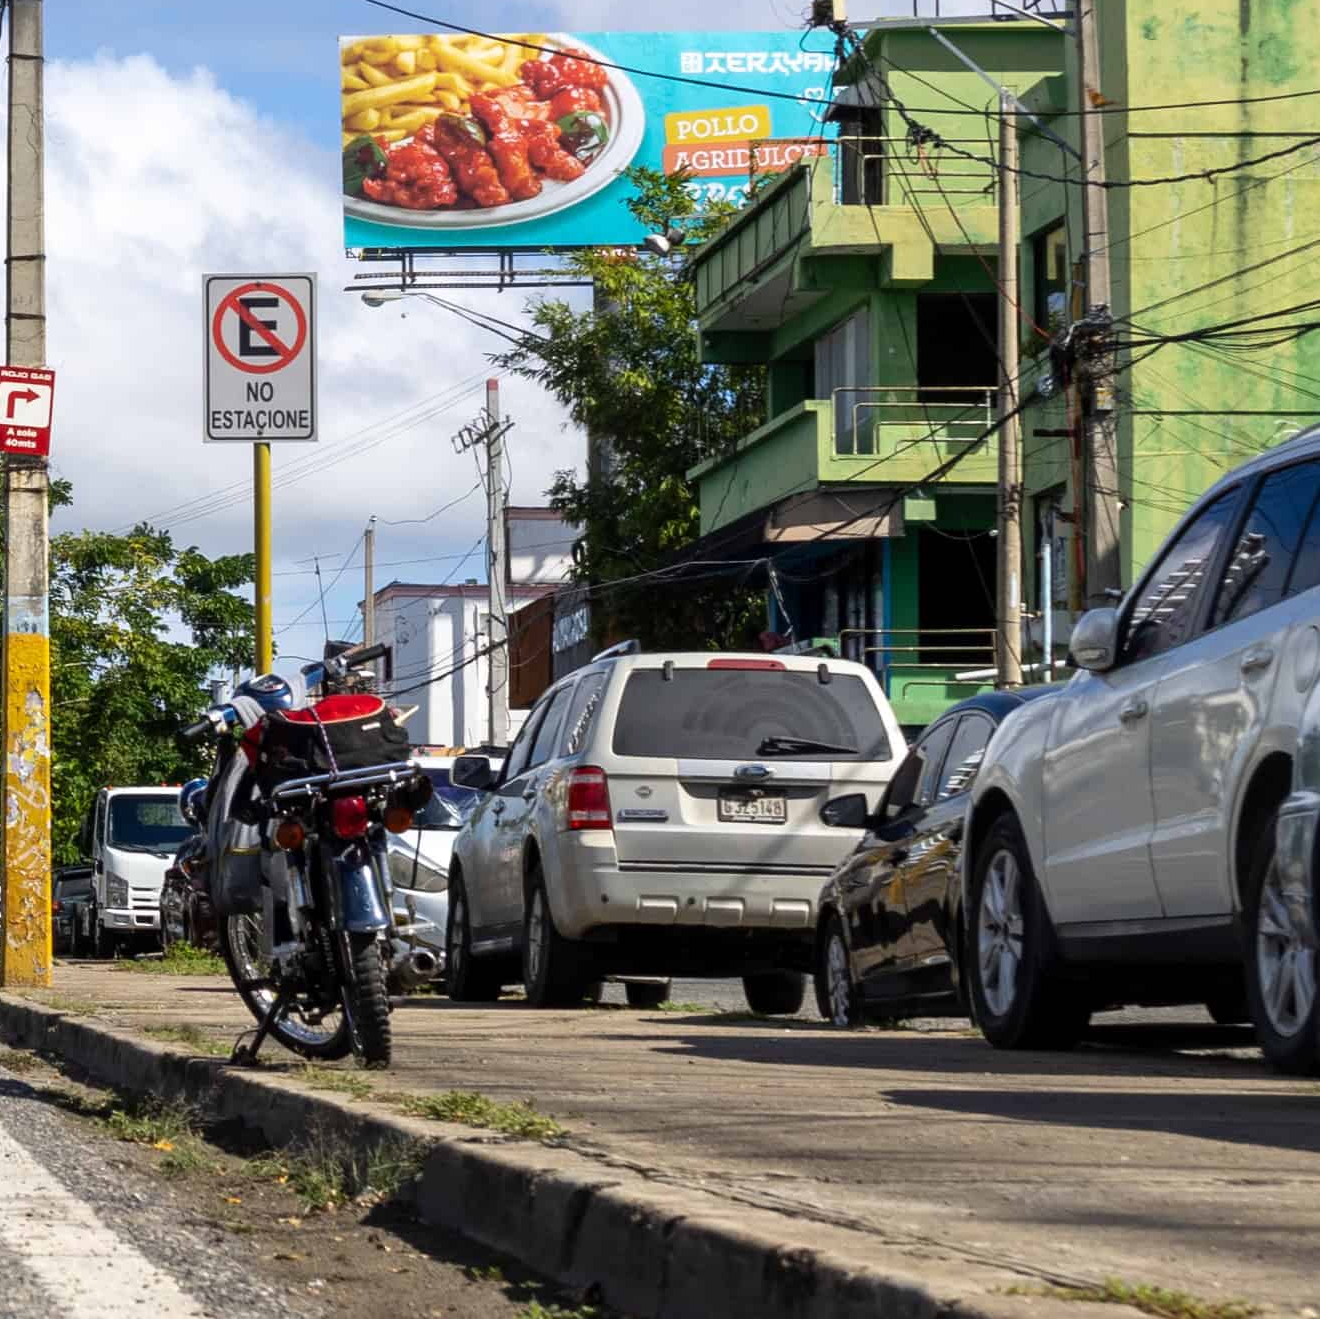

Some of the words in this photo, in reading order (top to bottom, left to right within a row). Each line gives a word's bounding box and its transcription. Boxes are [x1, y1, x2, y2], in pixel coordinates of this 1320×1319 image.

[677, 114, 759, 140] POLLO
[674, 144, 818, 171] AGRIDULCE
[246, 381, 274, 403] NO
[211, 410, 309, 429] ESTACIONE
